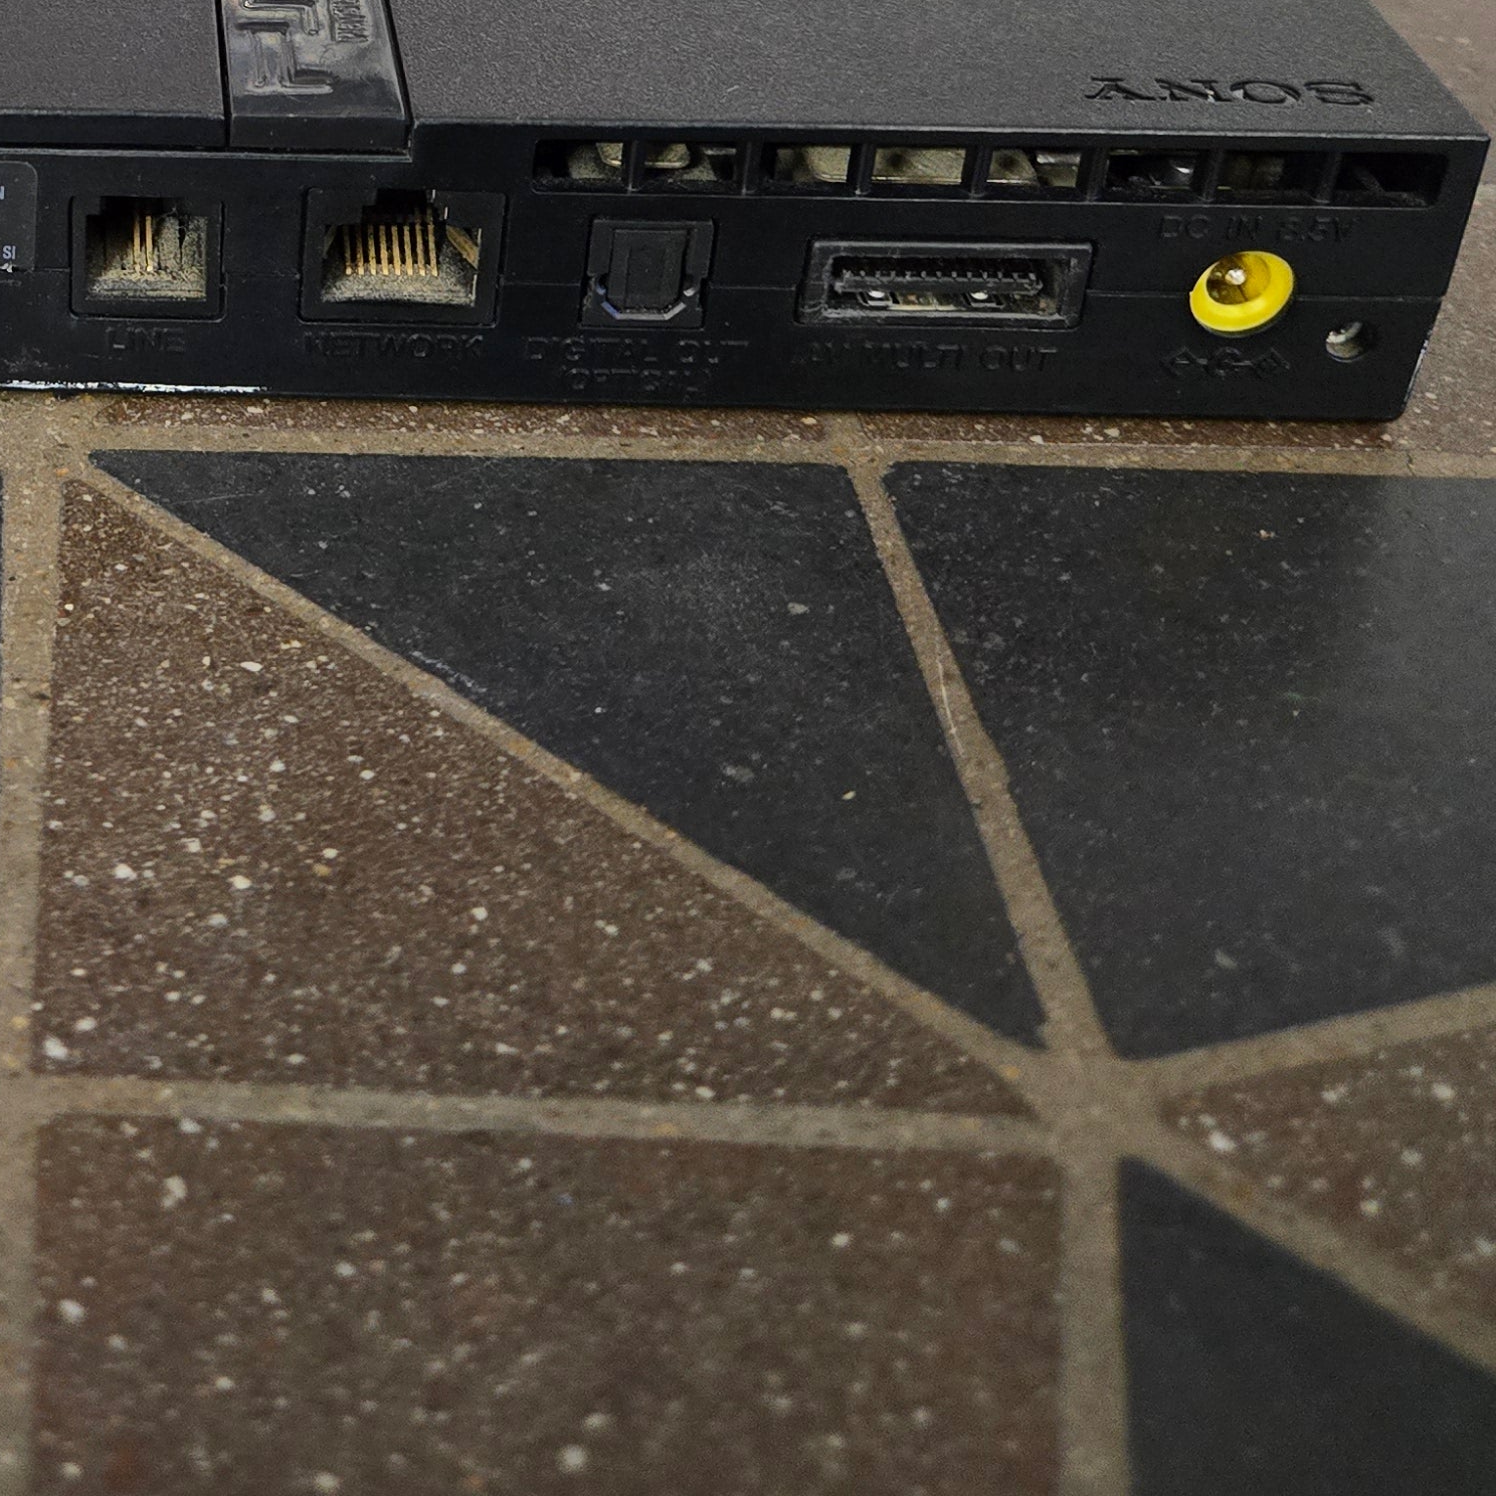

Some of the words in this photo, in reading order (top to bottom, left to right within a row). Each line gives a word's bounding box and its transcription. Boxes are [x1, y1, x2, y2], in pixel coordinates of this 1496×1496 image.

[1084, 76, 1375, 105] SONY
[1160, 214, 1211, 240] DC
[1225, 215, 1264, 242] IN
[2, 246, 16, 259] SI
[105, 327, 185, 353] LINE
[304, 331, 485, 359] NETWORK
